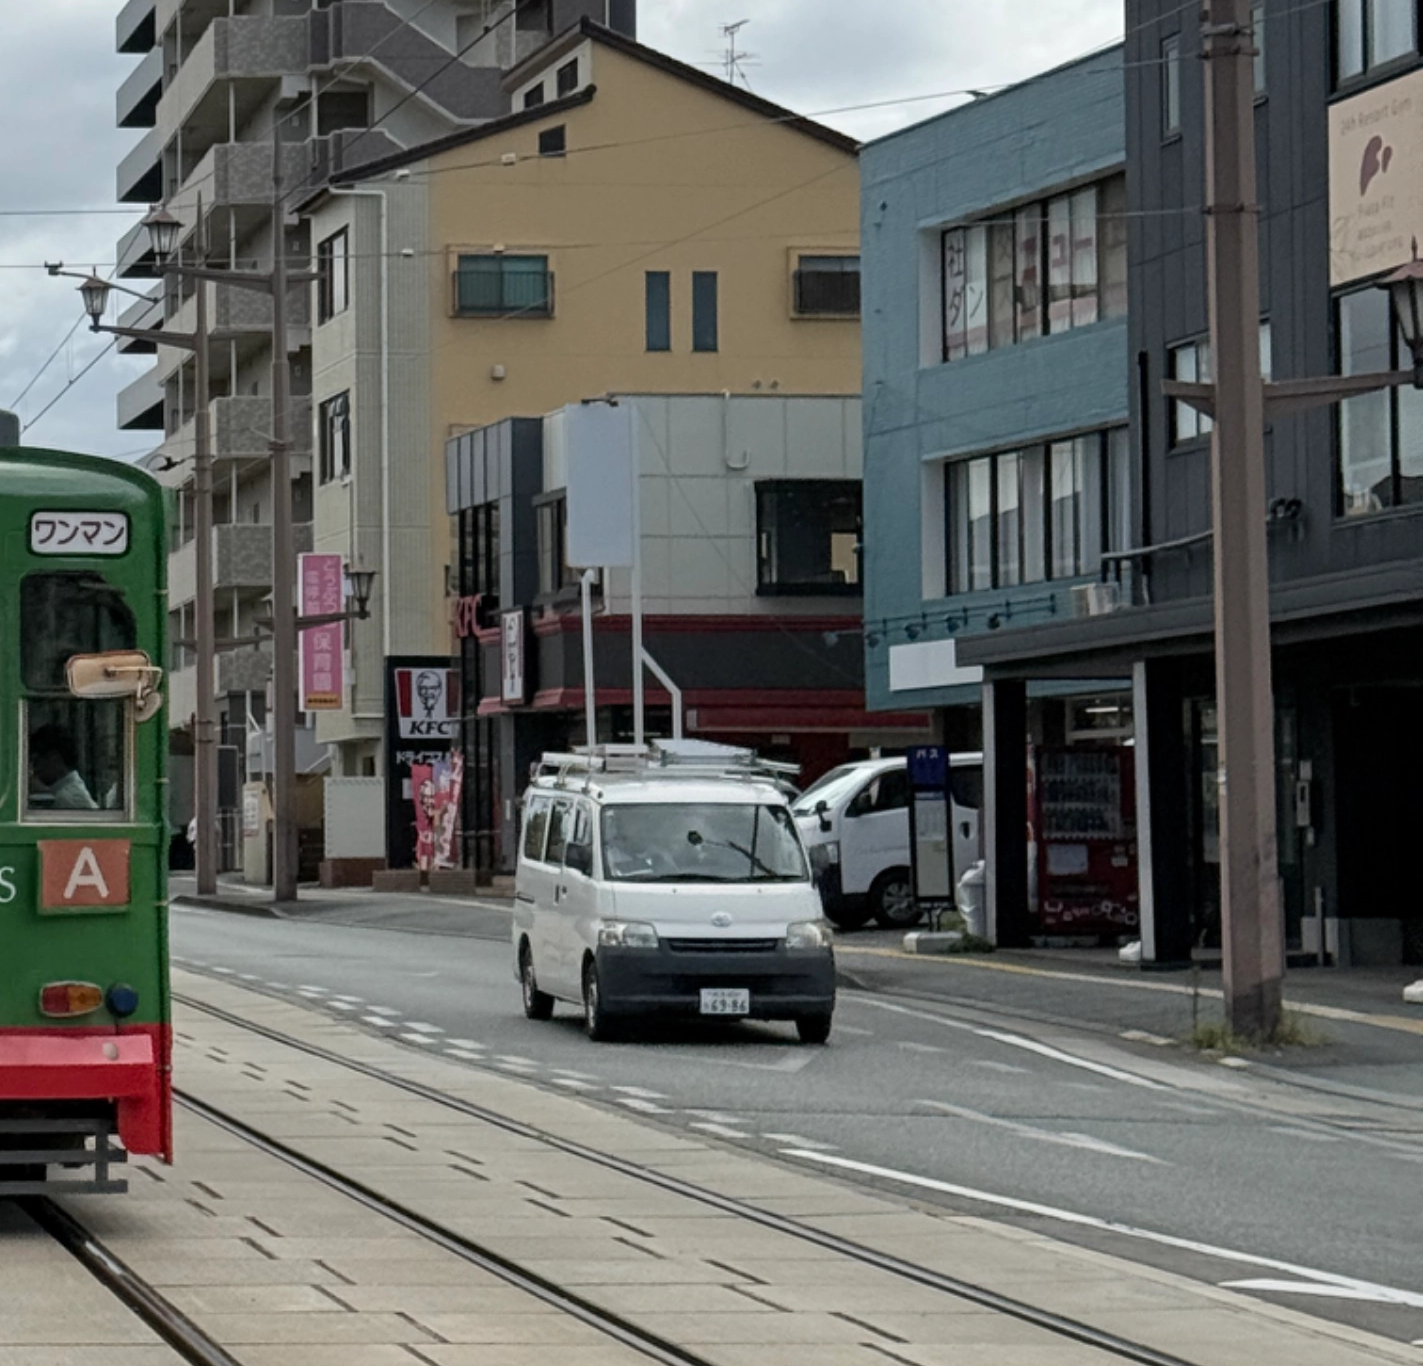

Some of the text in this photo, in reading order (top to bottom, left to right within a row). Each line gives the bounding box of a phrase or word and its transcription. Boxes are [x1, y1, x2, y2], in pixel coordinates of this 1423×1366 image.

[33, 518, 124, 546] ワンマン
[409, 719, 450, 736] KFC
[63, 846, 110, 900] A
